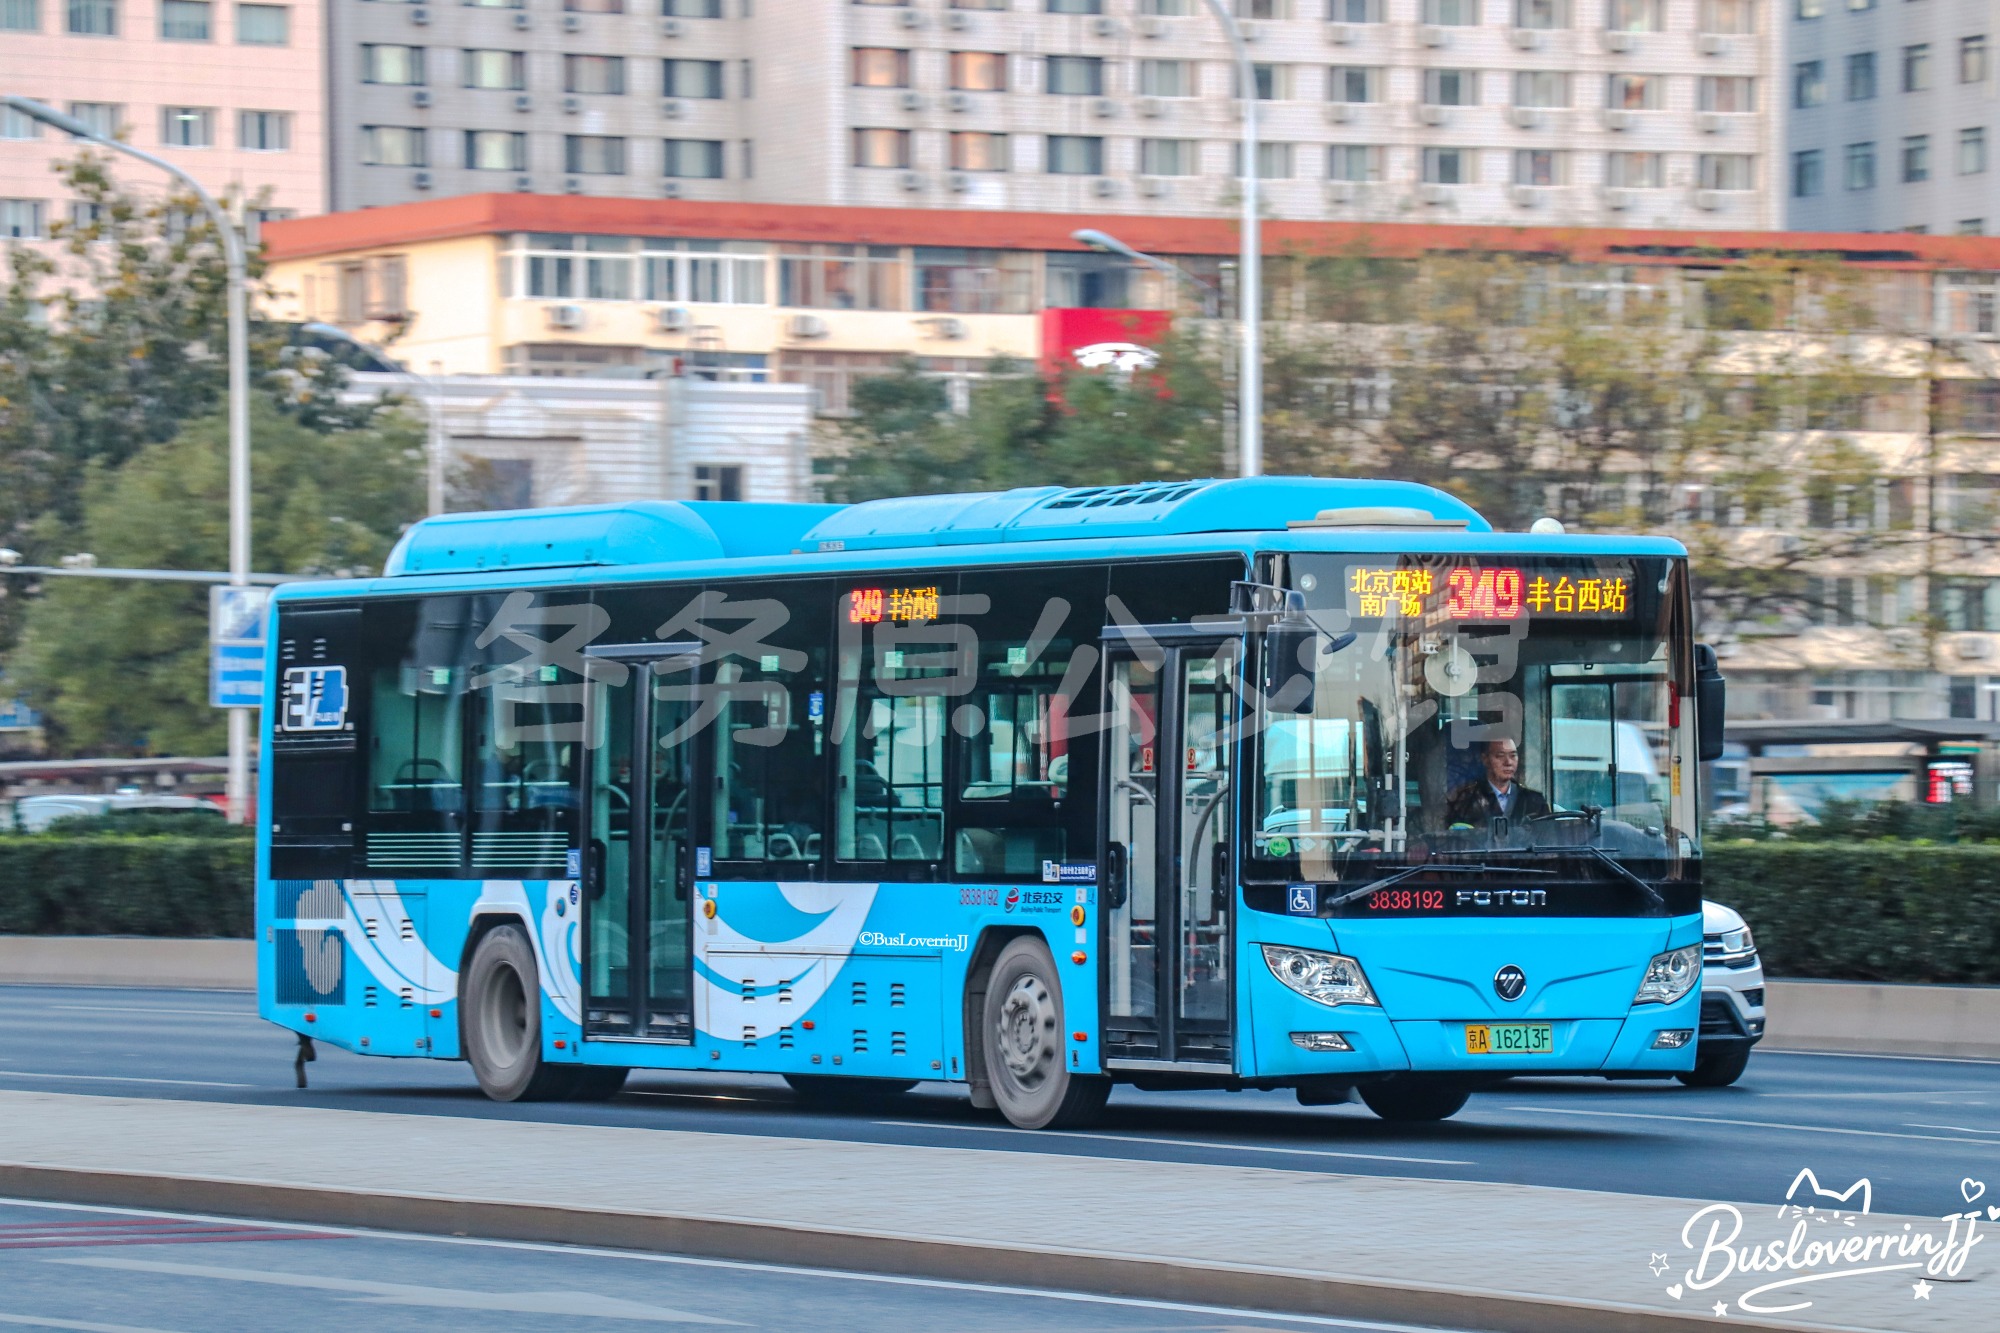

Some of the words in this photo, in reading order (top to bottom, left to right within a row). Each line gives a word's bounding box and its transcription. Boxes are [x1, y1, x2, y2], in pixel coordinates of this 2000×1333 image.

[1349, 568, 1433, 595] 北京西站
[849, 588, 883, 623] 349
[887, 586, 940, 621] 丰台西站
[1449, 569, 1520, 618] 349
[1526, 576, 1627, 613] 丰台西站
[1359, 594, 1422, 617] 南广场
[959, 888, 999, 906] 3838192
[1021, 891, 1064, 905] 北京公交
[1368, 890, 1444, 909] 3838192
[1456, 889, 1547, 906] FOTON
